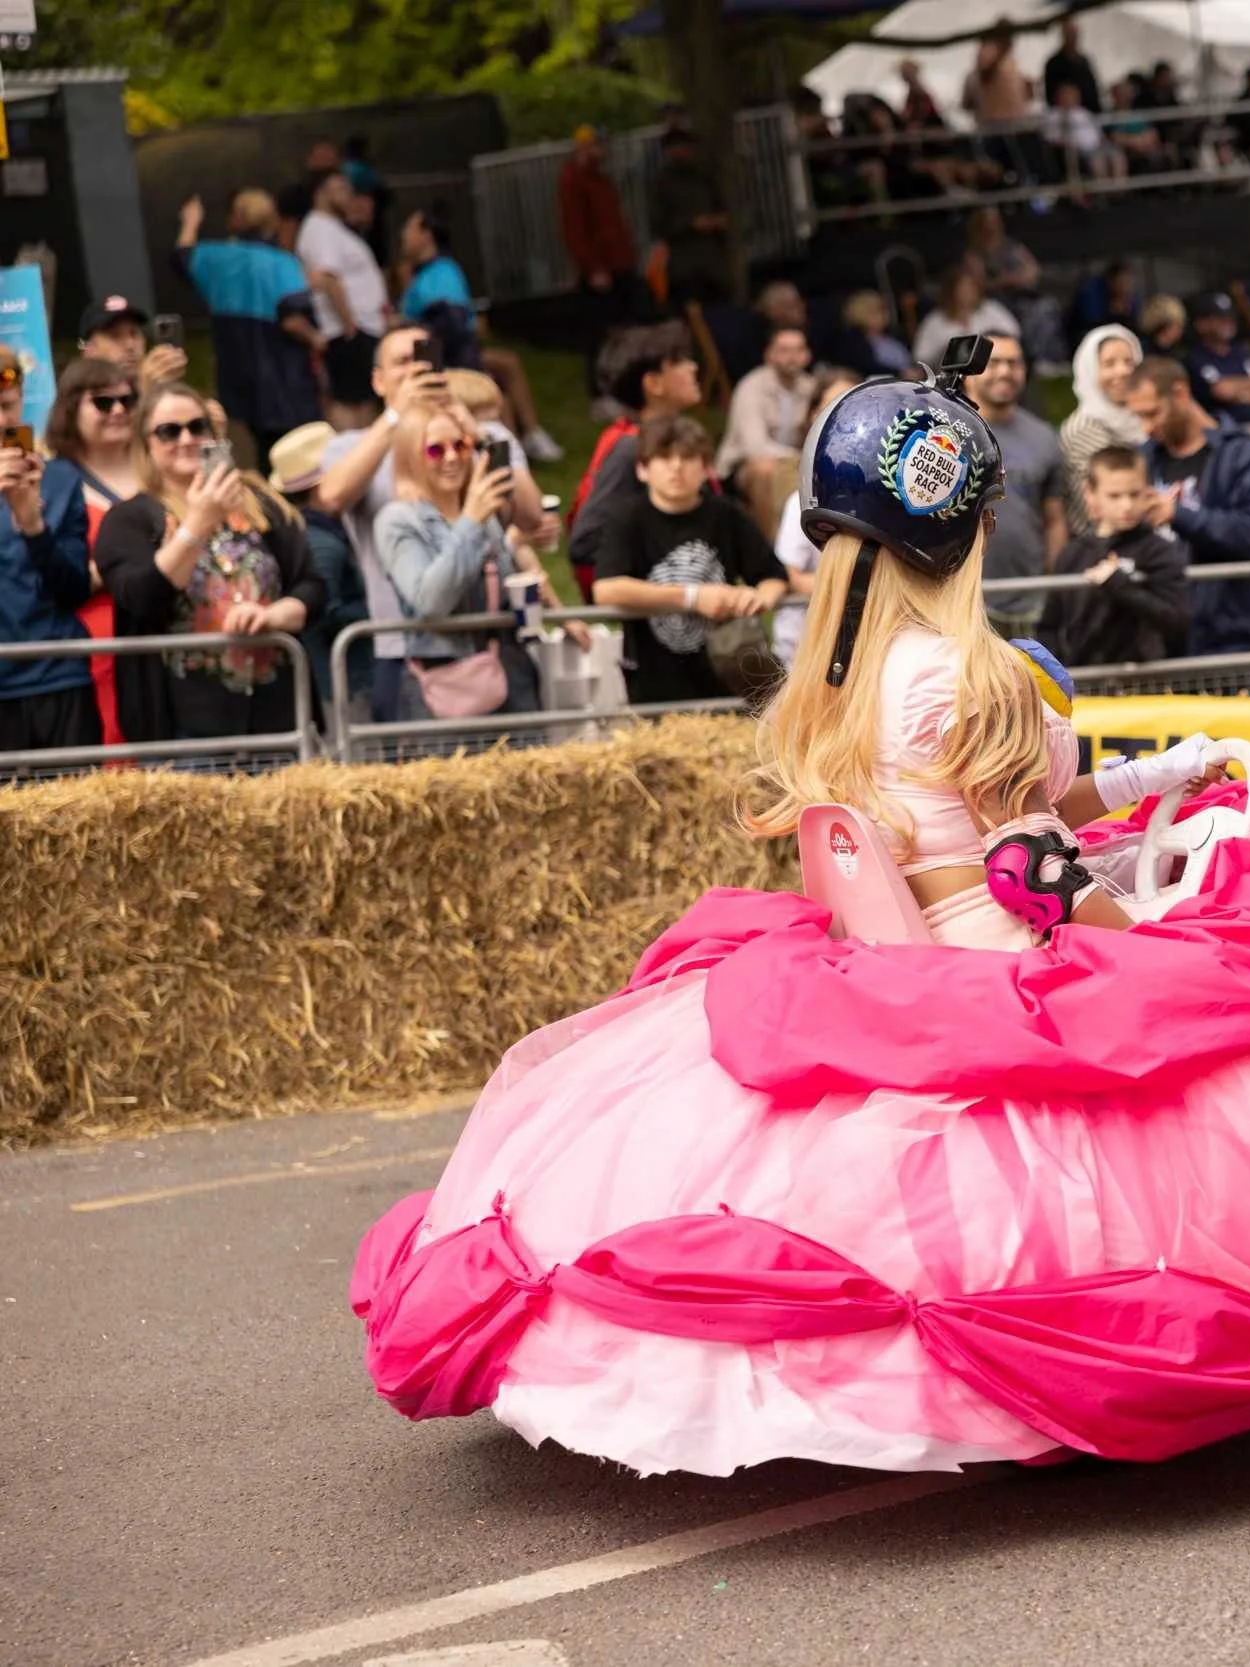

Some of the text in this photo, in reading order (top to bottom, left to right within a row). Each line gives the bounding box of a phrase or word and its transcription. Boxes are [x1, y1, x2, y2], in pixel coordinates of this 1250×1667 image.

[910, 456, 953, 488] SOAPBOX
[917, 445, 956, 476] RED BULL
[914, 473, 940, 495] RACE
